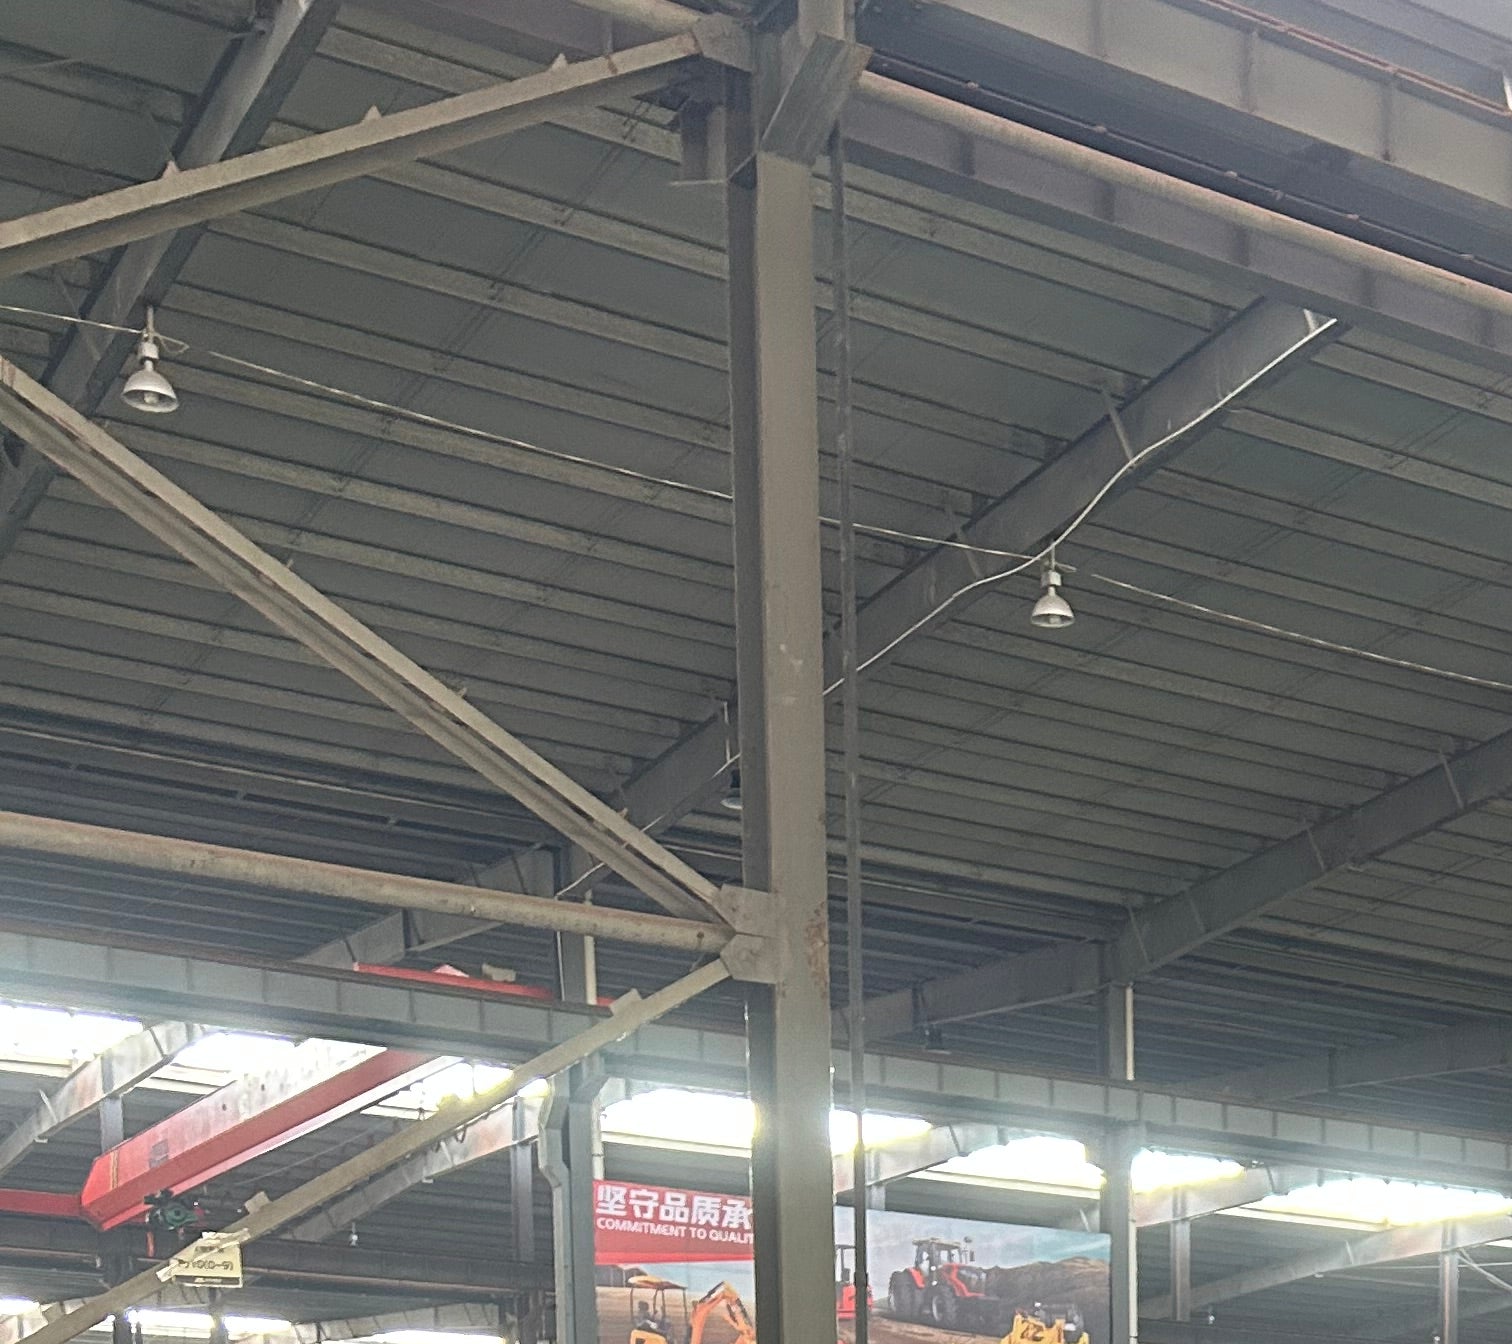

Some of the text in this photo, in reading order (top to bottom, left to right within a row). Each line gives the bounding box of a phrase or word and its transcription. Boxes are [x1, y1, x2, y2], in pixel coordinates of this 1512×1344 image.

[596, 1185, 752, 1229] 坚守品质承
[597, 1217, 686, 1237] COMMITMENT
[690, 1227, 707, 1240] TO
